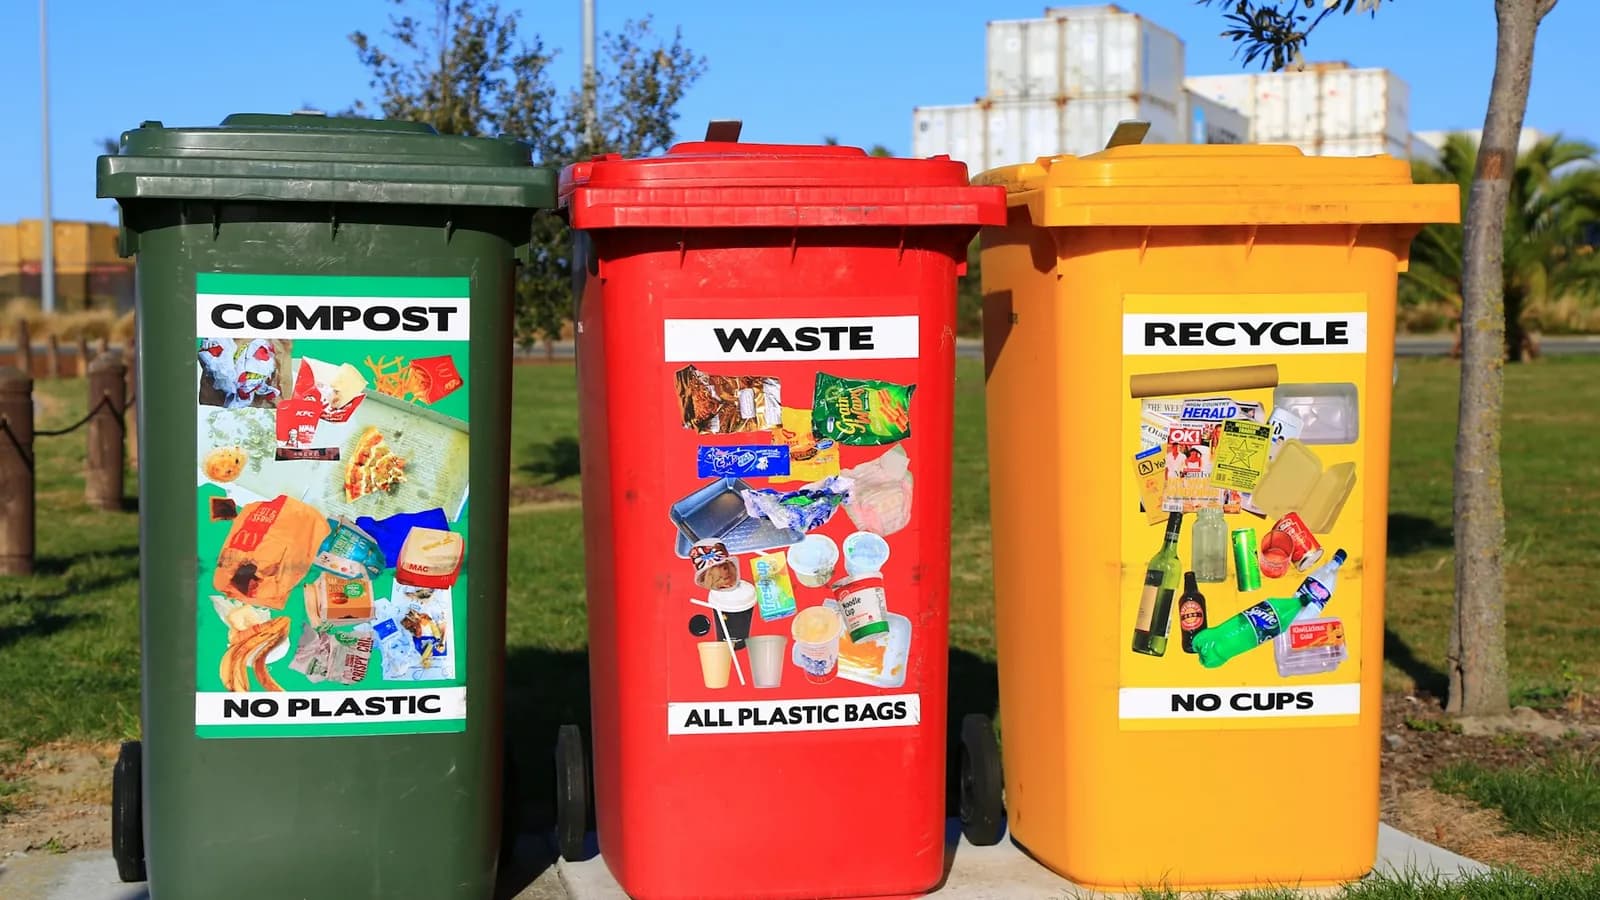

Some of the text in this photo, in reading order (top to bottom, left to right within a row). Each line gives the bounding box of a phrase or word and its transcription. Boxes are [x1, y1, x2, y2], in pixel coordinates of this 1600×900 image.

[211, 303, 458, 332] COMPOST
[713, 326, 875, 352] WASTE
[1144, 321, 1349, 346] RECYCLE
[295, 410, 316, 418] KFC
[835, 395, 866, 435] Grain
[1182, 406, 1237, 419] HERALD
[1170, 429, 1200, 443] OK!
[408, 563, 430, 573] MAC
[756, 561, 775, 611] fresh up
[842, 596, 861, 609] Noodle
[844, 607, 855, 617] Cup
[1245, 606, 1277, 625] Sprite
[351, 655, 368, 682] CRISPY
[223, 694, 441, 718] NO PLASTIC
[1171, 691, 1314, 712] NO CUPS
[684, 701, 907, 728] ALL PLASTIC BAGS
